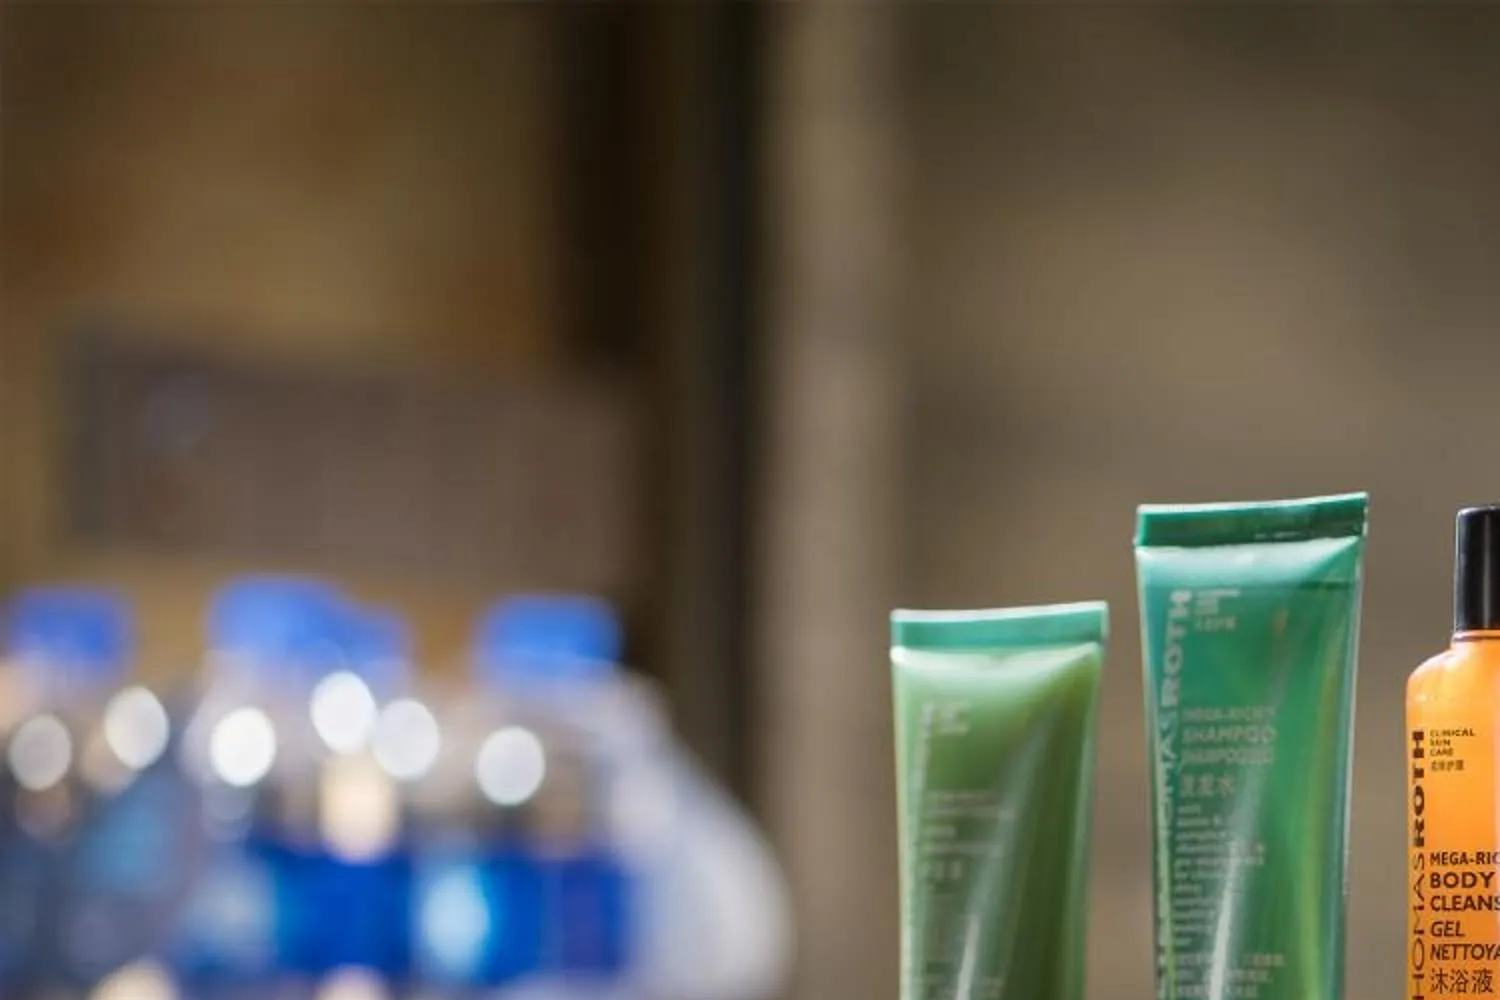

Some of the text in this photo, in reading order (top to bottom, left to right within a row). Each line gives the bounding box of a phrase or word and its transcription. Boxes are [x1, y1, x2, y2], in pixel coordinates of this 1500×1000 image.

[1430, 872, 1495, 888] BODY
[1431, 921, 1465, 937] GEL
[1430, 968, 1493, 994] 沐浴液
